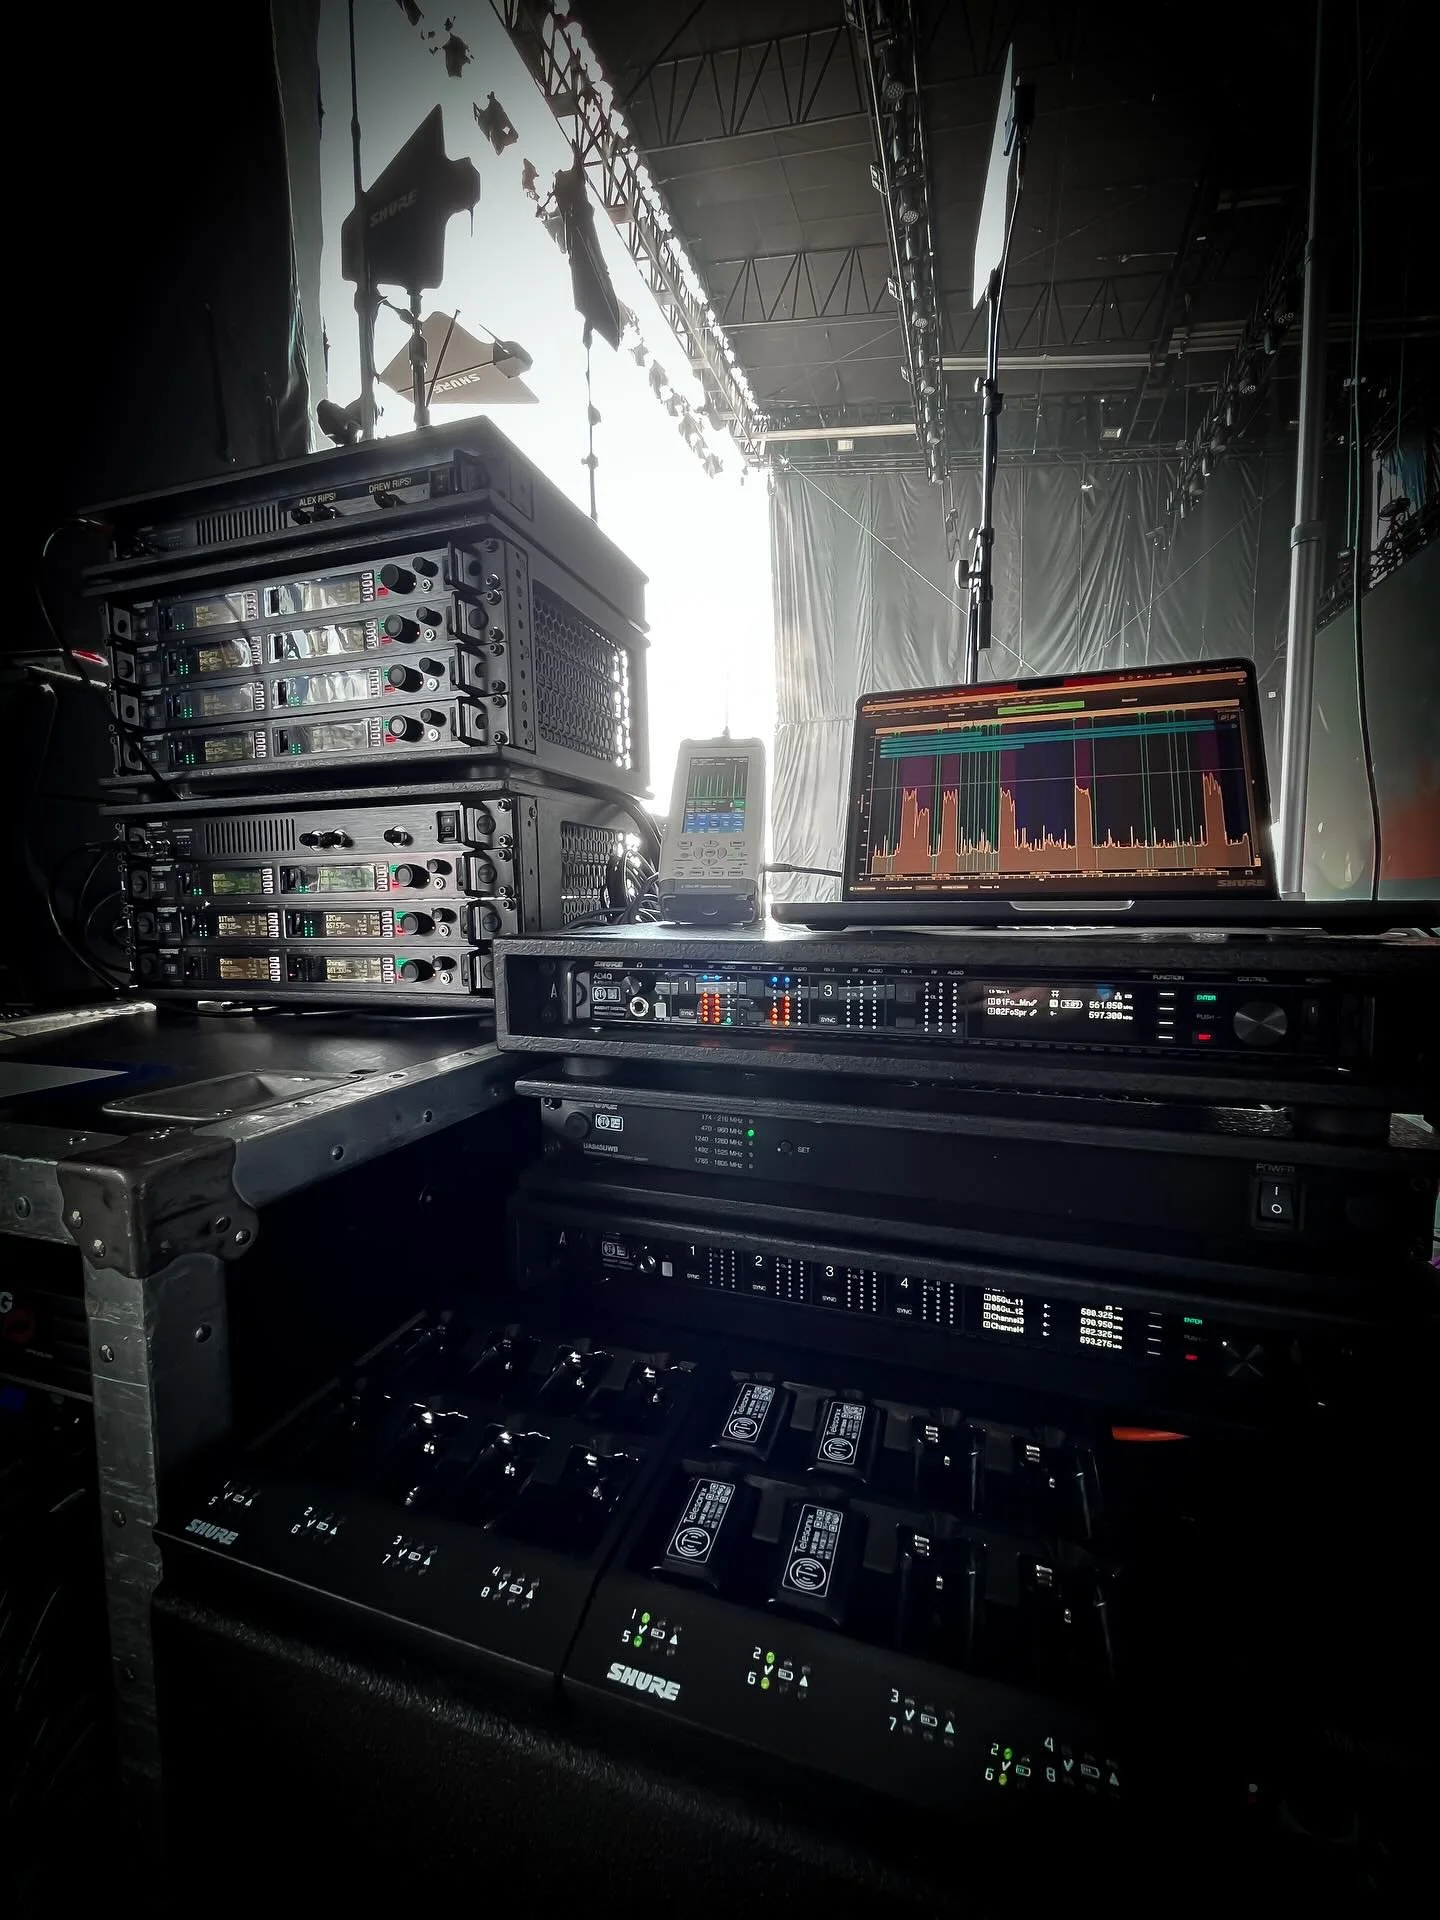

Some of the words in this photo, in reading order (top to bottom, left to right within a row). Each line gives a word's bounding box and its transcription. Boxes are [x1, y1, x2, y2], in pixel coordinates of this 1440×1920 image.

[369, 187, 418, 228] SHURE
[434, 373, 481, 394] SHURE
[369, 481, 390, 493] DREW
[392, 477, 412, 489] RIPS!
[299, 495, 317, 507] ALEX
[317, 492, 336, 504] RIPS!
[550, 982, 557, 999] A
[823, 984, 833, 997] 3
[1089, 1001, 1123, 1009] 561.850
[820, 1015, 836, 1024] SYNC
[1088, 1010, 1123, 1019] 597.300
[1255, 1163, 1295, 1173] POWER
[755, 1255, 763, 1267] 2
[825, 1266, 834, 1277] 3
[752, 1284, 767, 1292] SYNC
[900, 1278, 909, 1289] 4
[822, 1295, 837, 1303] SYNC
[897, 1308, 912, 1316] SYNC
[304, 1506, 313, 1516] 2
[185, 1519, 239, 1545] SHURE
[291, 1524, 301, 1534] 6
[393, 1535, 402, 1544] 3
[492, 1566, 501, 1576] 4
[481, 1586, 490, 1597] 8
[622, 1630, 631, 1642] 5
[753, 1647, 761, 1660] 2
[607, 1662, 681, 1701] SHURE
[747, 1671, 756, 1685] 6
[891, 1688, 899, 1703] 3
[889, 1717, 896, 1731] 7
[991, 1743, 999, 1756] 2
[1044, 1736, 1054, 1752] 4
[984, 1768, 993, 1781] 6
[1046, 1767, 1056, 1782] 8
